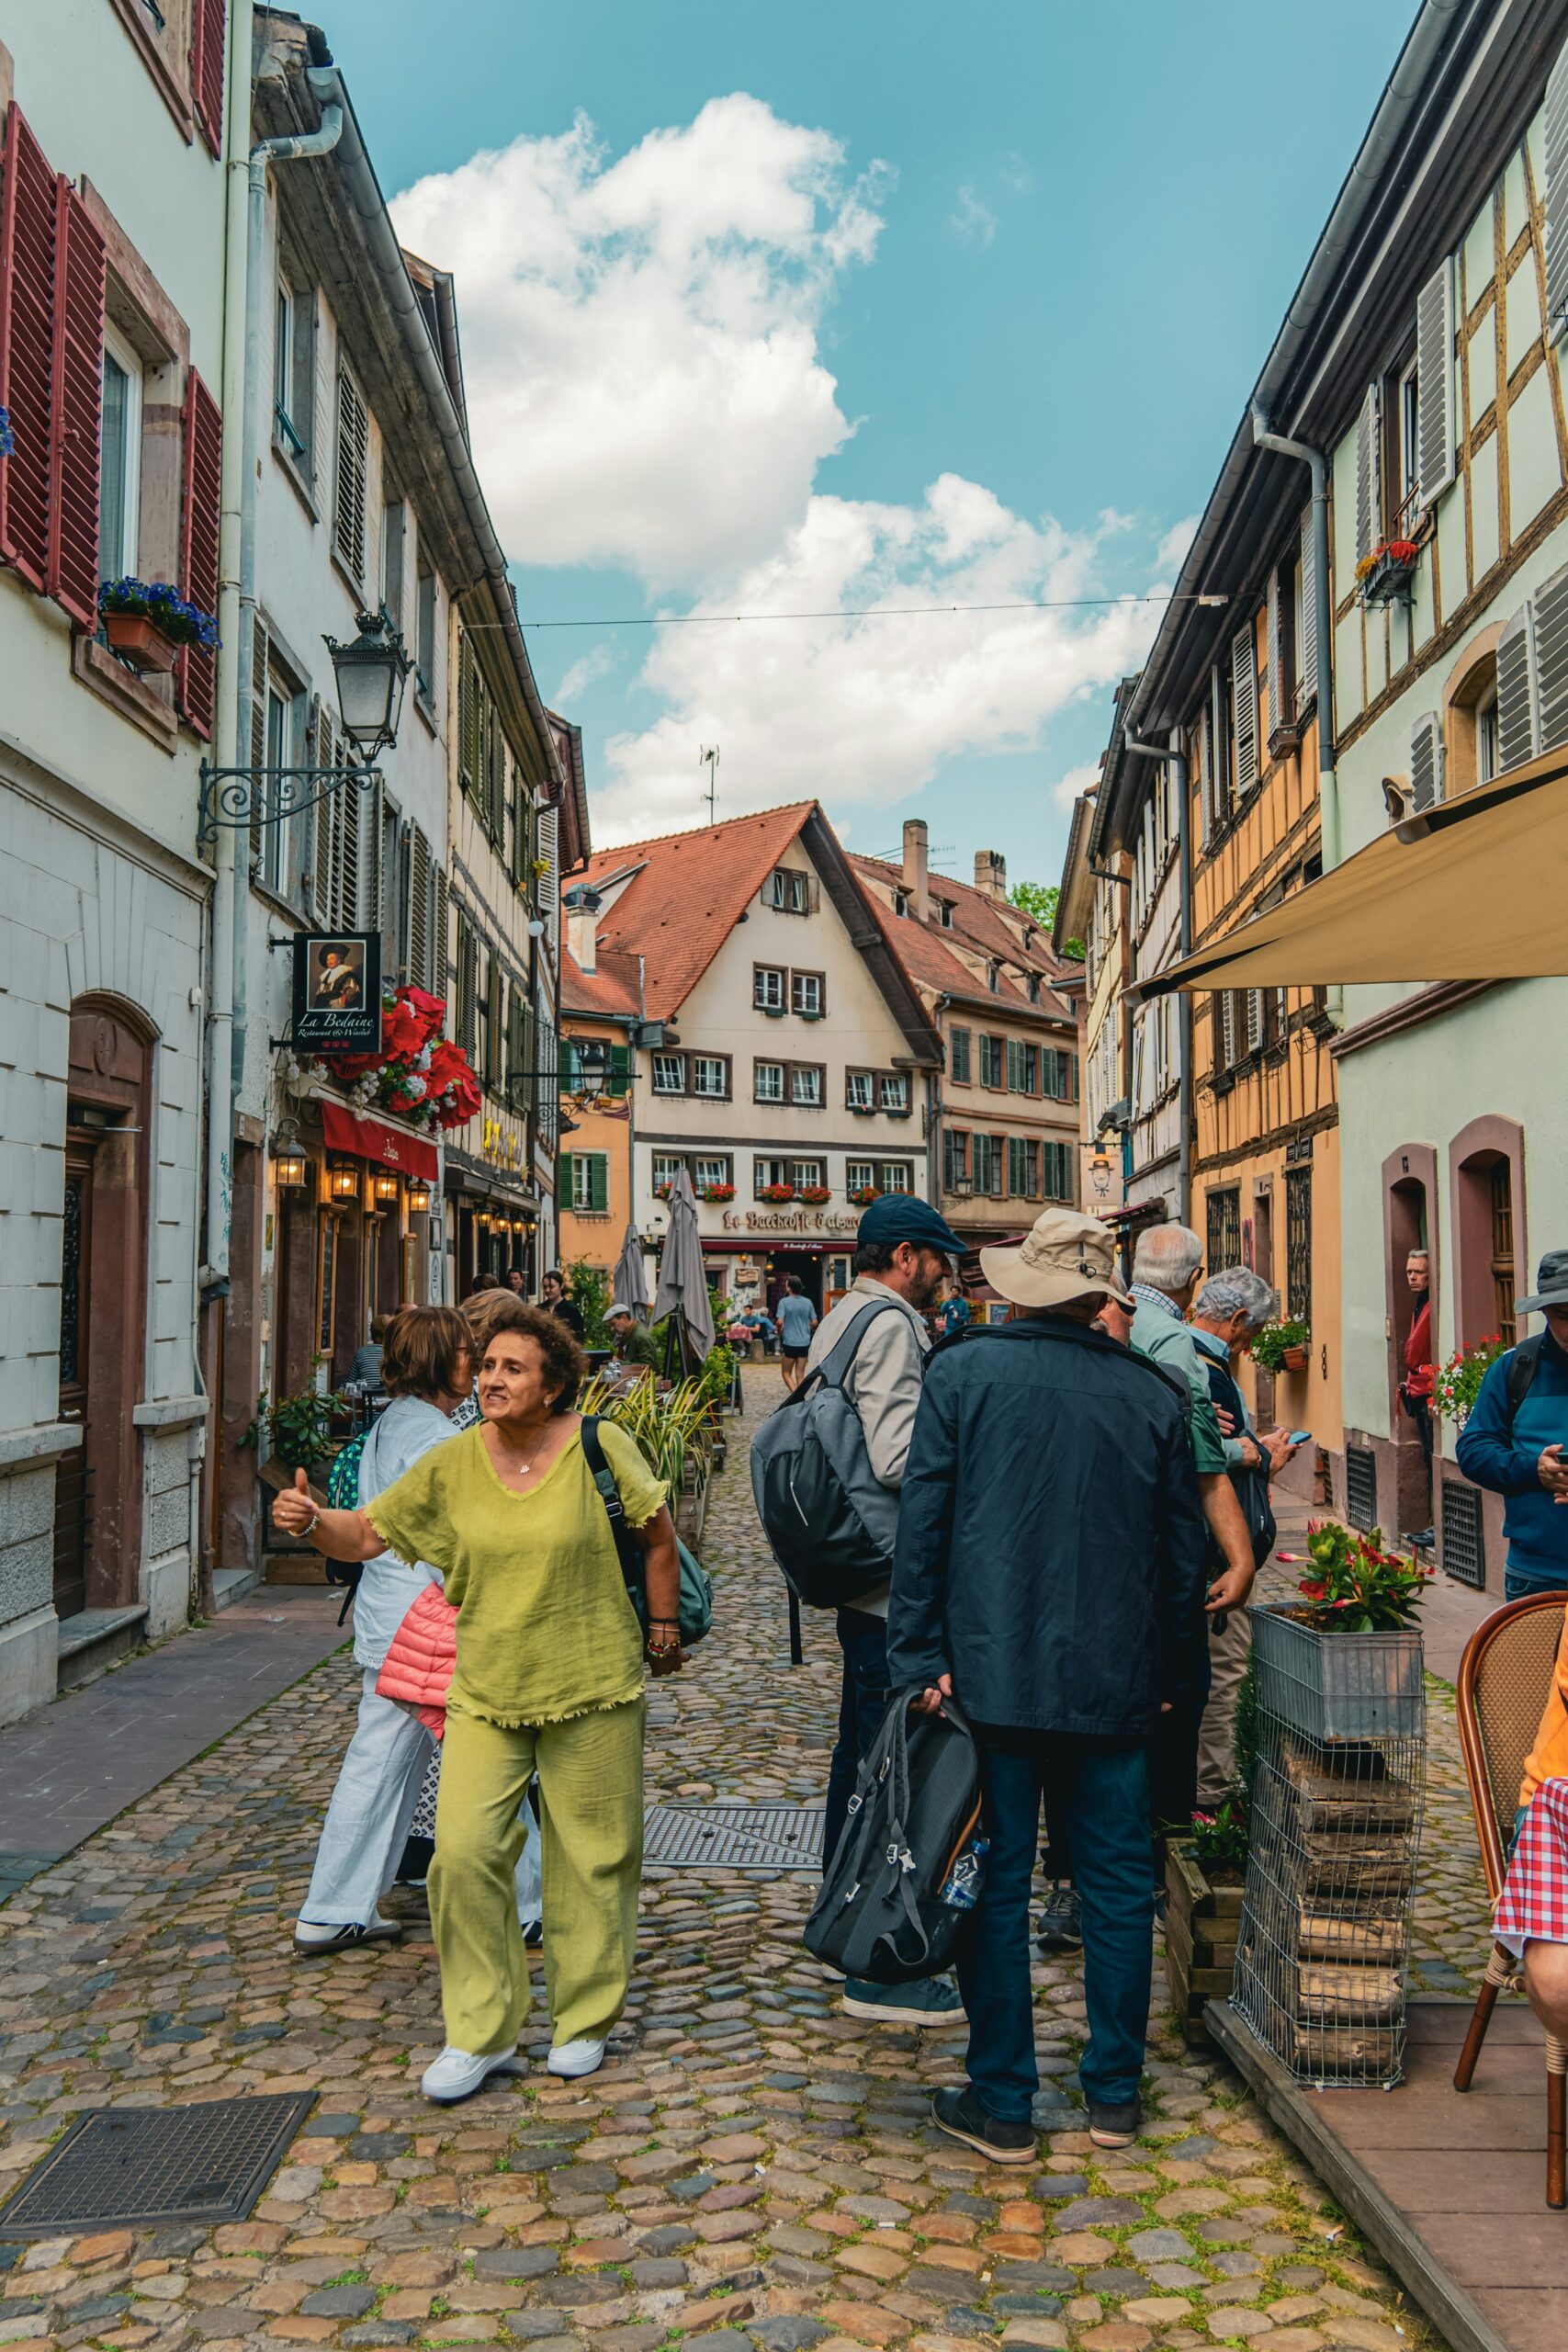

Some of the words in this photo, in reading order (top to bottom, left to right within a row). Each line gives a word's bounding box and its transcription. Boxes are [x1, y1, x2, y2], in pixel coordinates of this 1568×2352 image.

[298, 1012, 320, 1027] La
[323, 1012, 374, 1028] Bedaine
[298, 1028, 332, 1038] Restaurant
[722, 1210, 739, 1229] Le
[746, 1211, 809, 1231] Baeckeoffe
